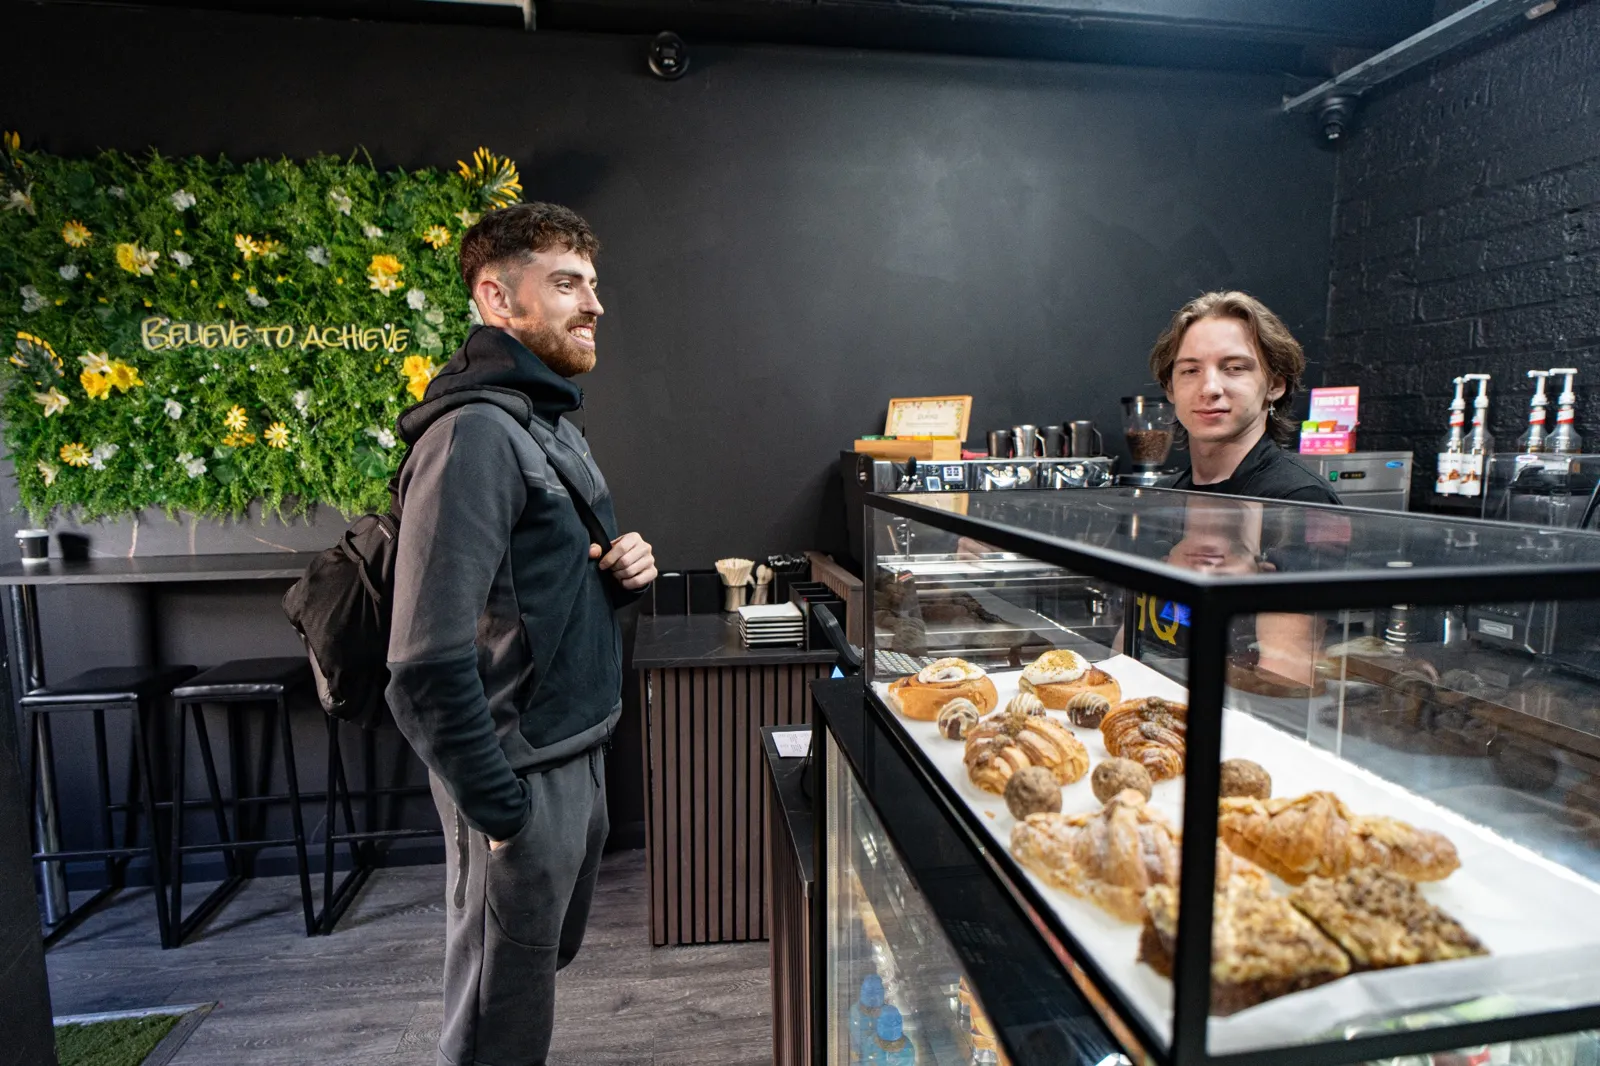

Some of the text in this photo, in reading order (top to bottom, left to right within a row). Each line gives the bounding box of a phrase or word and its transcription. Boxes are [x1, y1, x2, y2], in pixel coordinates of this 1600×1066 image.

[141, 316, 410, 352] BELIEVE TO ACHIEVE
